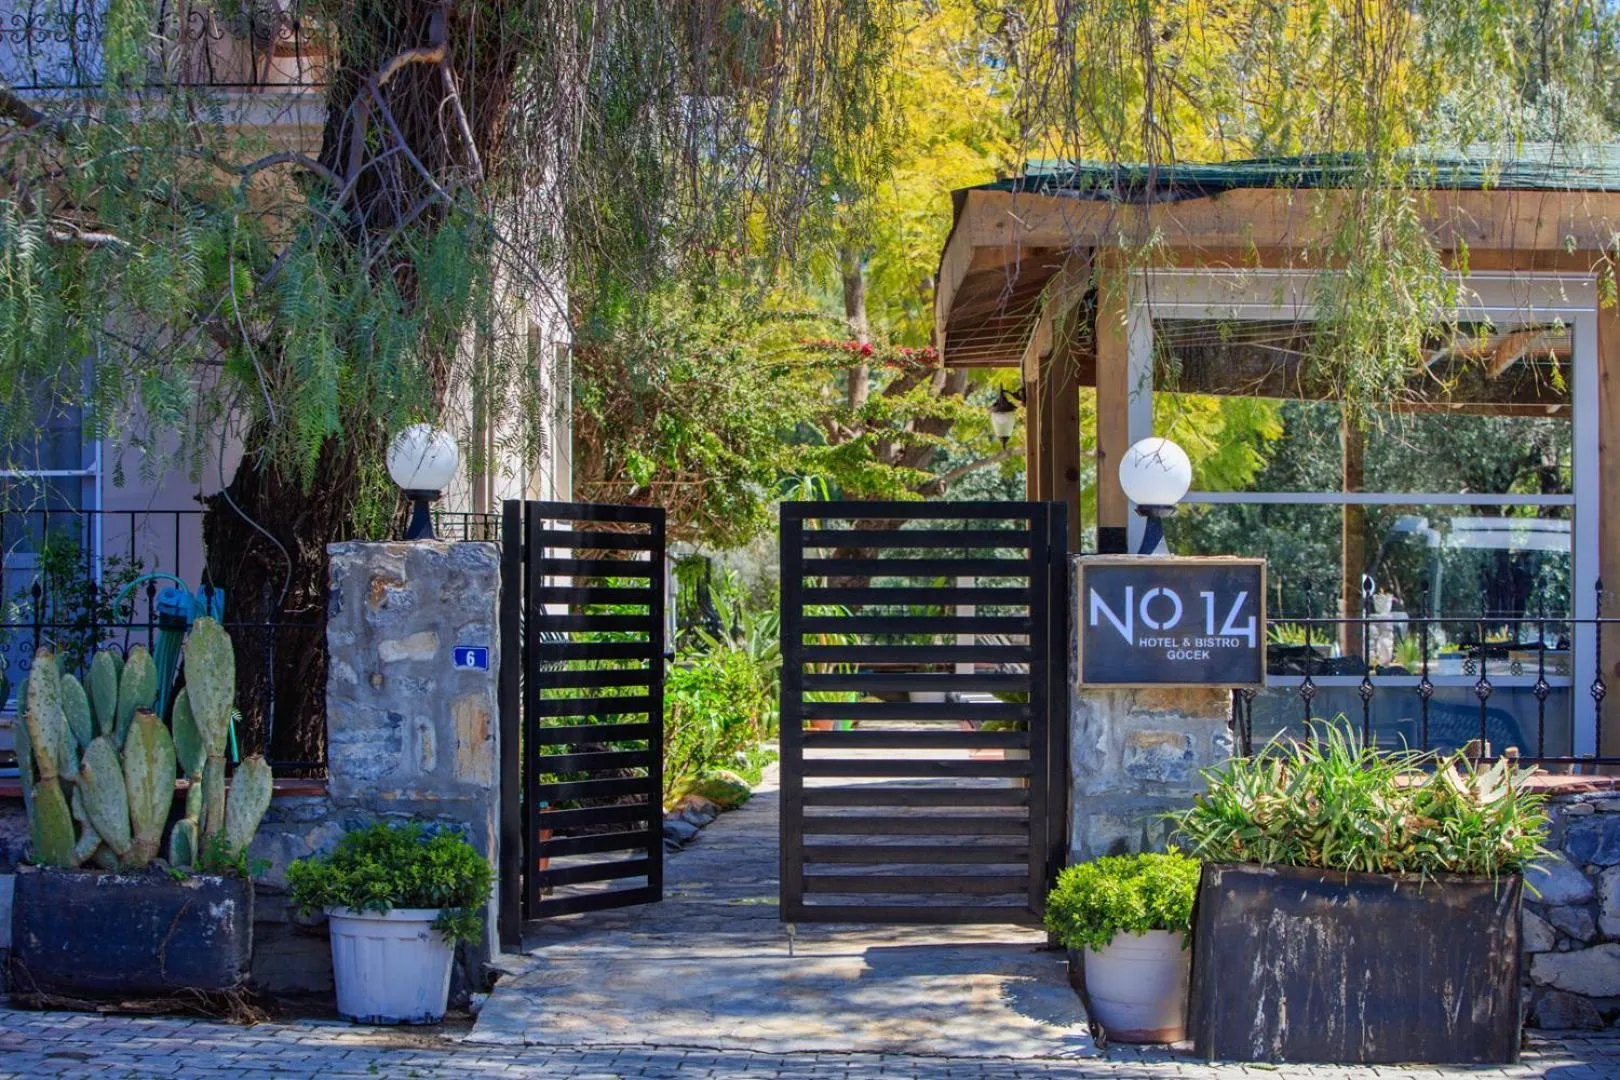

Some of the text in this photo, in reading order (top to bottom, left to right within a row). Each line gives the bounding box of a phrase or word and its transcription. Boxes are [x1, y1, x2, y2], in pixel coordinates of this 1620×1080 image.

[1090, 586, 1256, 648] NO 14
[1139, 637, 1240, 648] HOTEL & BISTRO
[466, 651, 475, 667] 6
